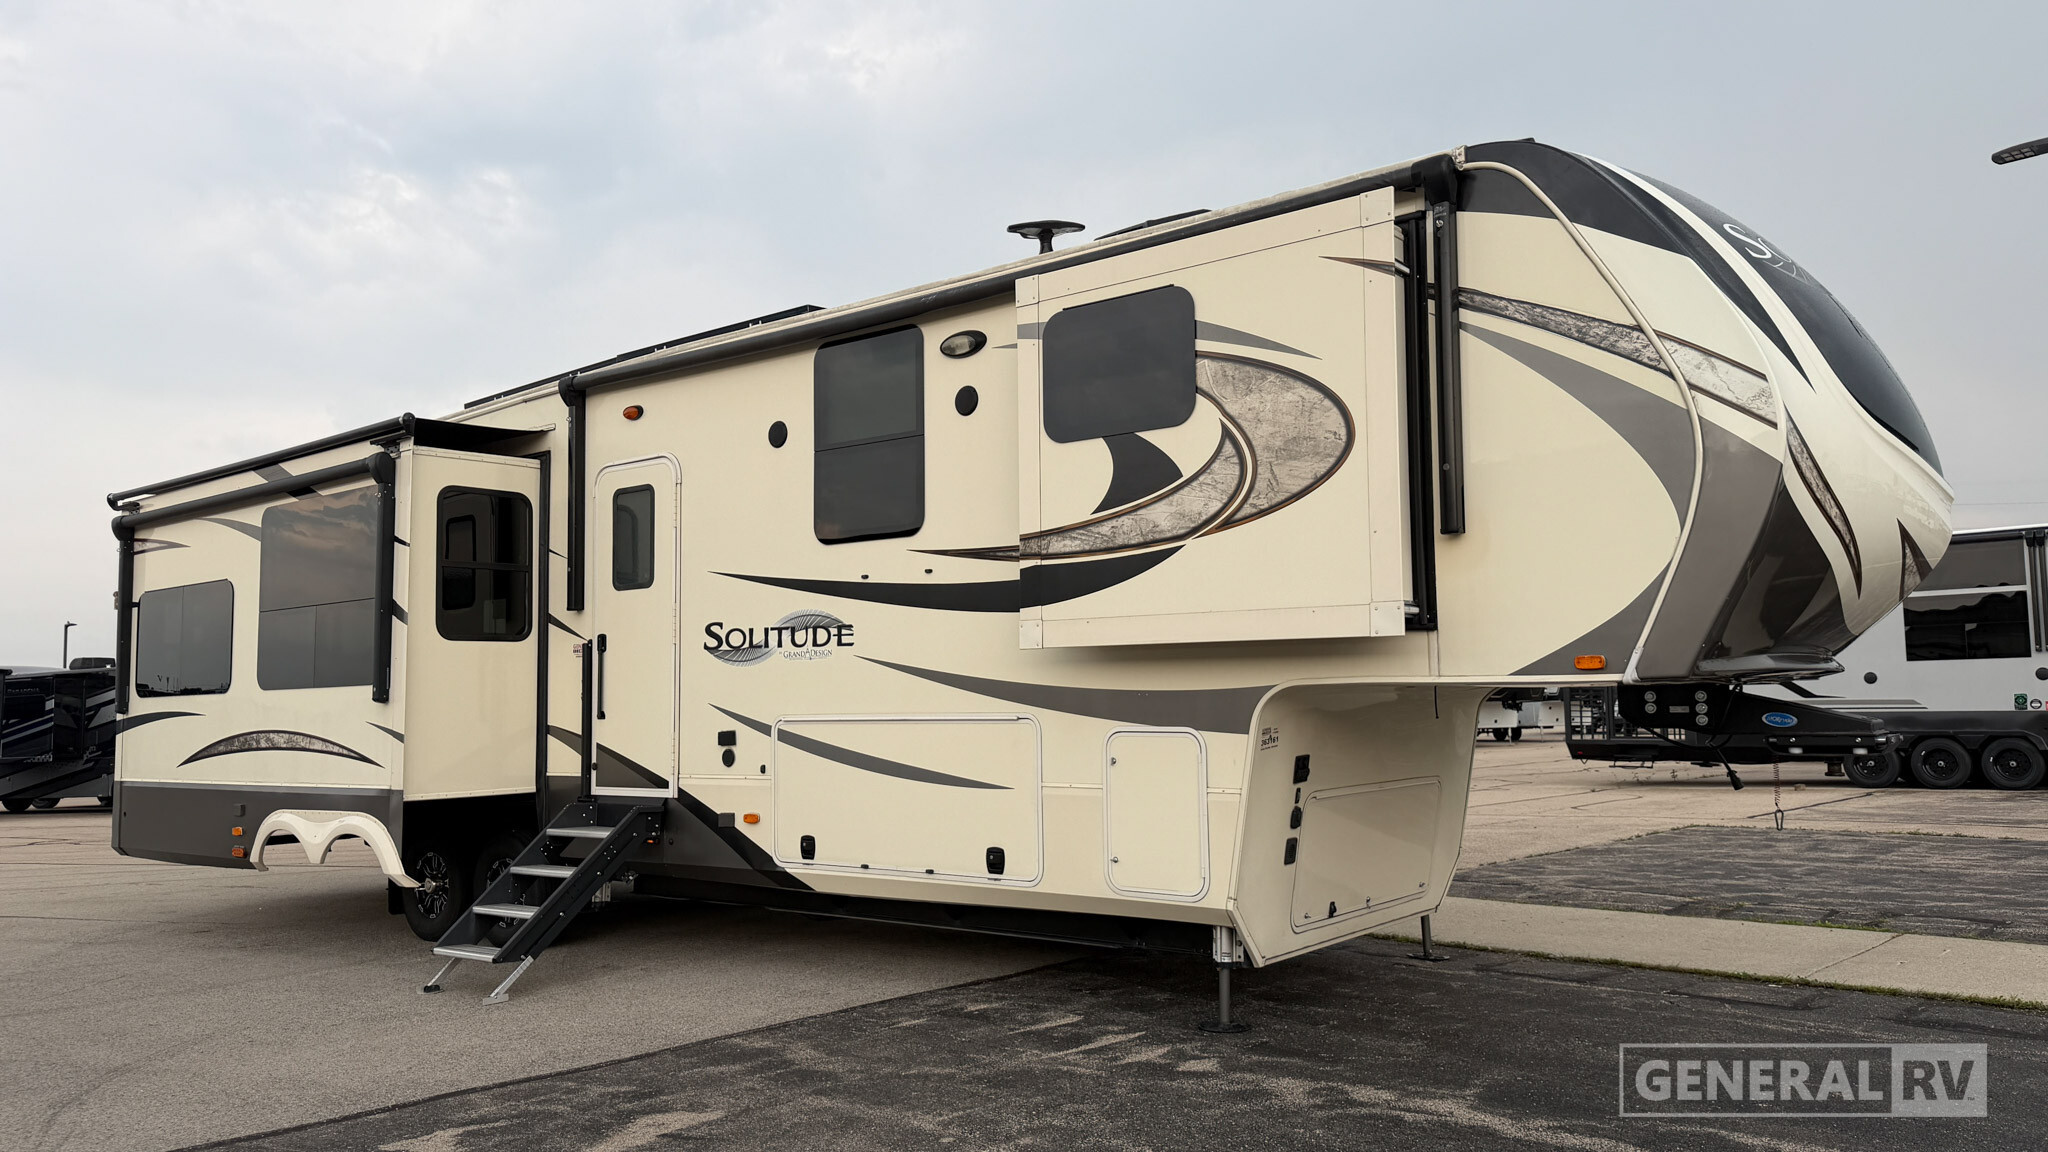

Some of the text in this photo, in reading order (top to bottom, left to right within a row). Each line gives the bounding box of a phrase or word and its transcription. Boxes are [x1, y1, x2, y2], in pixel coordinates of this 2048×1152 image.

[703, 622, 855, 650] SOLITUDE
[783, 651, 806, 659] GRAND
[810, 649, 833, 657] DESIGN
